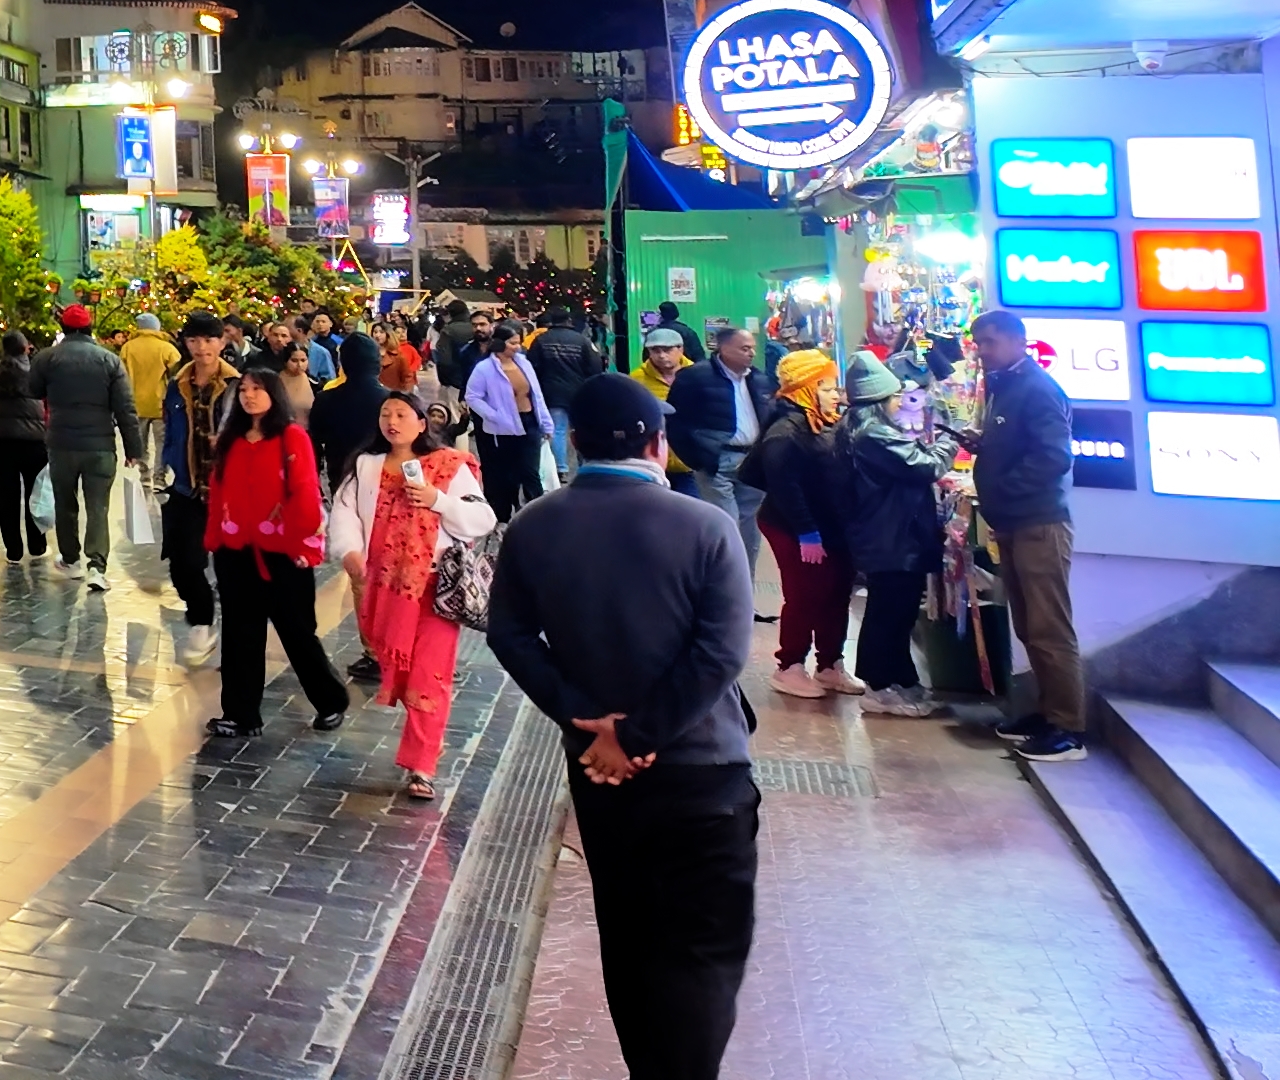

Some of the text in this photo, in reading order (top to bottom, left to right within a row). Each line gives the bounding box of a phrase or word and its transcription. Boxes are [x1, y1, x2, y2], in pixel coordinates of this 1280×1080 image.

[718, 29, 844, 65] LHASA
[711, 54, 860, 91] POTALA
[1071, 348, 1120, 372] LG
